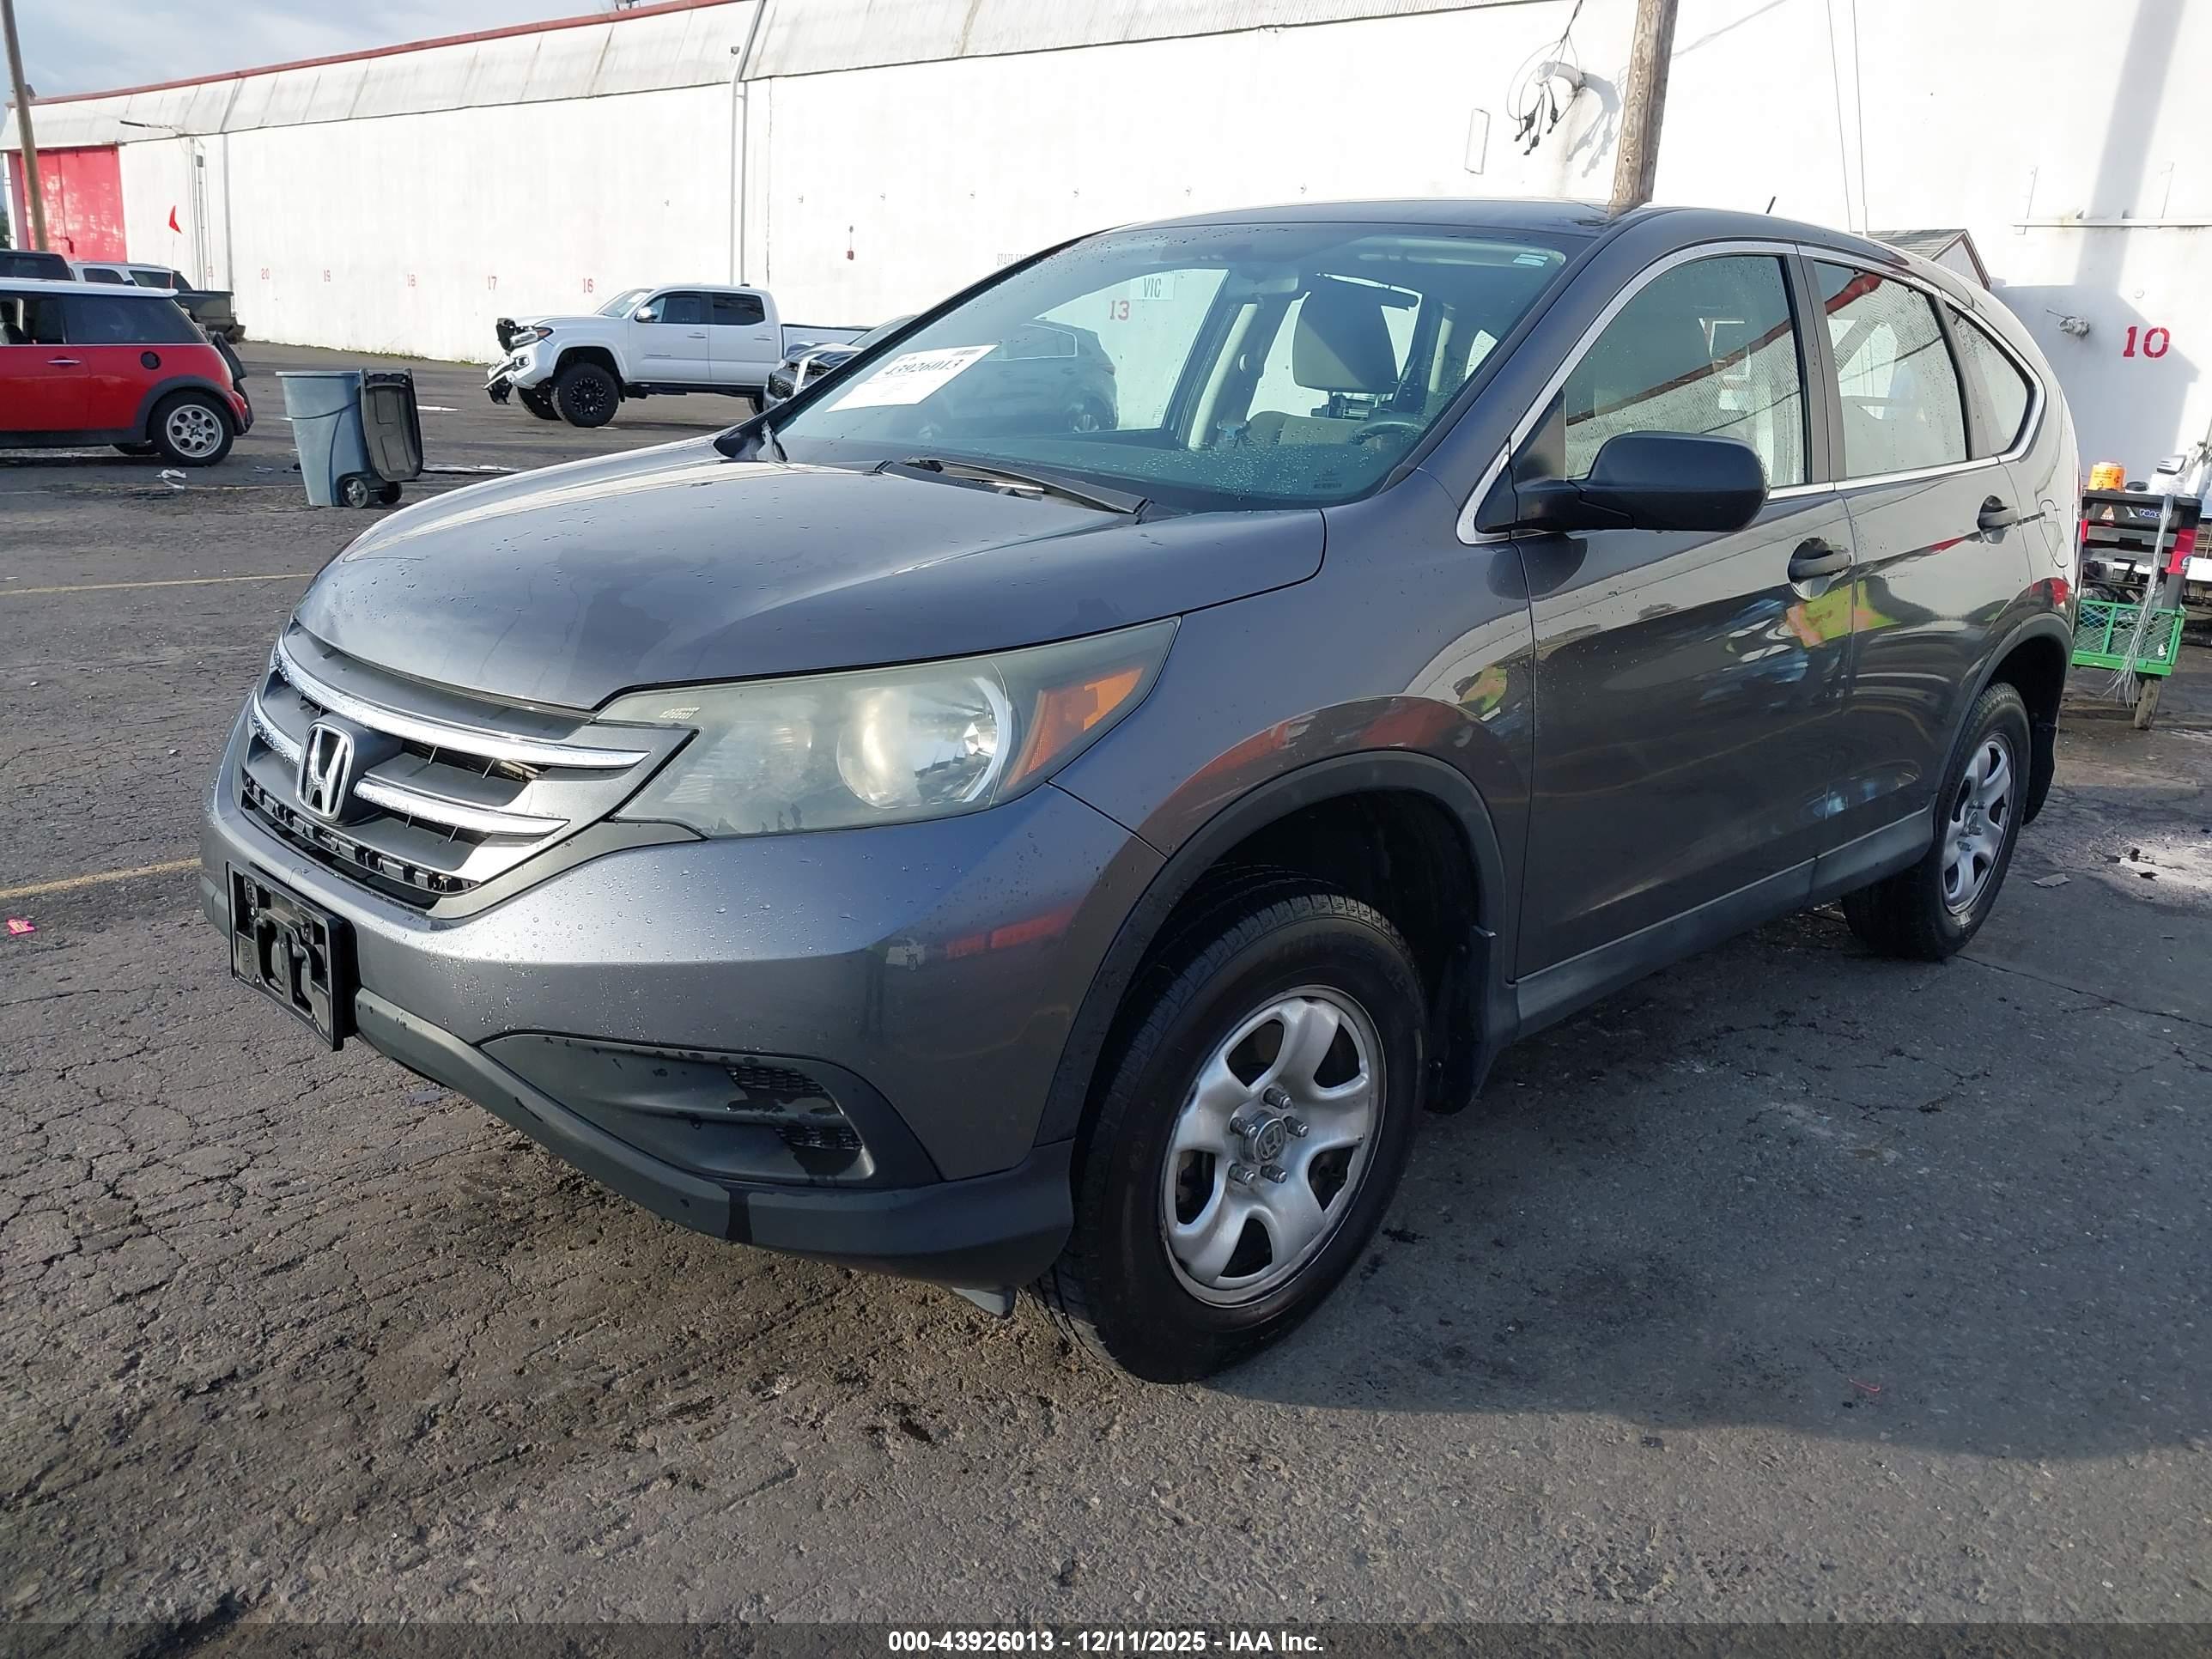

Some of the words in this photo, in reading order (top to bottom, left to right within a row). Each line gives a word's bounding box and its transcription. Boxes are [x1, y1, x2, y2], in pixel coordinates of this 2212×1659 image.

[261, 268, 270, 280] 20
[324, 270, 331, 282] 19
[407, 274, 416, 287] 18
[488, 275, 497, 290] 17
[583, 277, 594, 294] 16
[1144, 277, 1162, 298] VIC
[1109, 300, 1130, 320] 13
[2123, 325, 2171, 358] 10
[884, 358, 964, 376] 43926013
